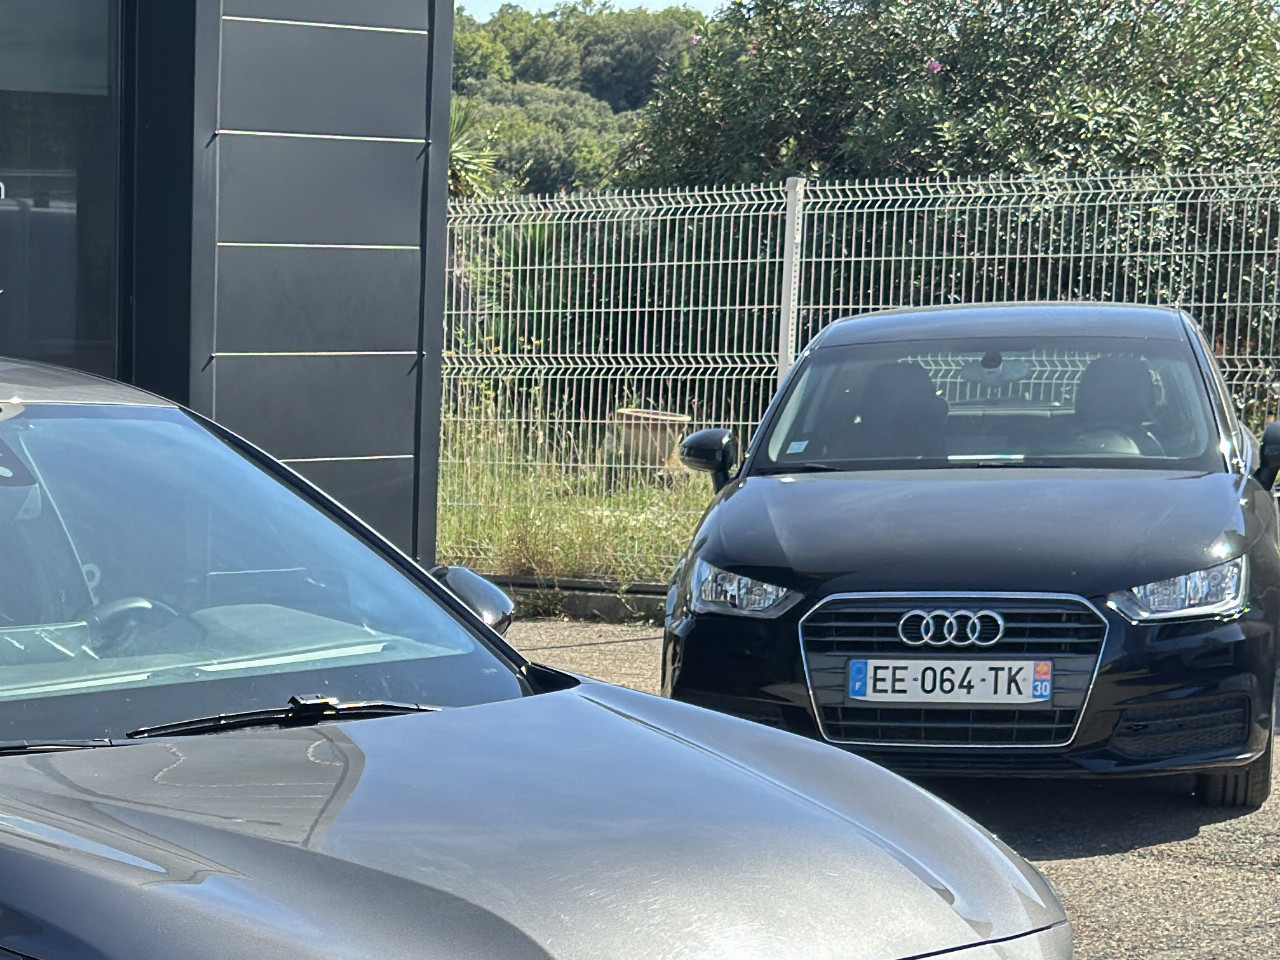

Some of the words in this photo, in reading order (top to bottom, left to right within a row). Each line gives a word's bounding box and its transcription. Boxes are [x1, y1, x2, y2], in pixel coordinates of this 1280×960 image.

[854, 682, 862, 691] F
[872, 666, 1024, 695] EE-064-TK
[1033, 681, 1050, 696] 30
